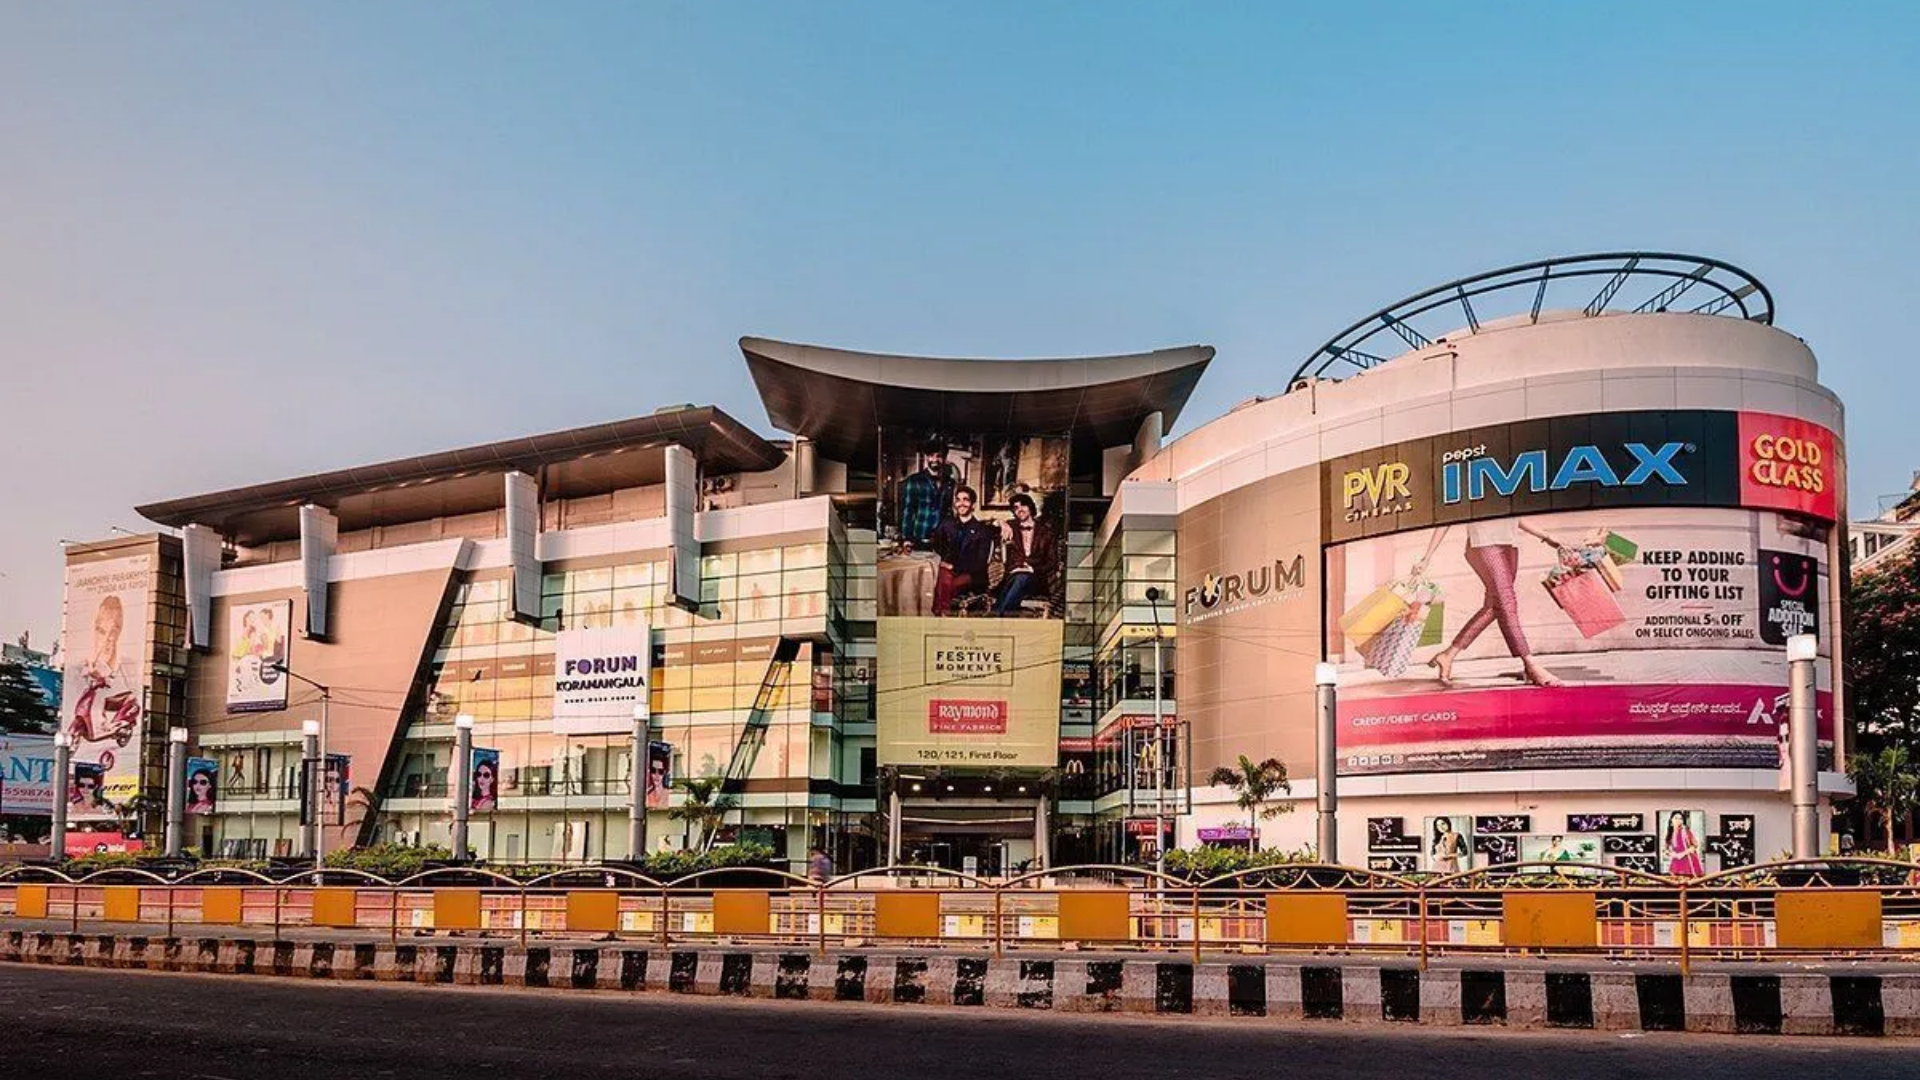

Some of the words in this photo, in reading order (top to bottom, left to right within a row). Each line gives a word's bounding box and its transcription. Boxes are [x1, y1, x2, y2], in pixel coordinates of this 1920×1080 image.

[1443, 444, 1487, 464] pepsi
[1754, 433, 1821, 465] GOLD
[1442, 442, 1689, 504] IMAX
[1752, 459, 1823, 493] CLASS
[1343, 462, 1411, 508] PVR
[1345, 502, 1413, 523] CINEMAS
[1642, 551, 1682, 565] KEEP
[1687, 551, 1745, 566] ADDING
[1661, 568, 1682, 582] TO
[1688, 568, 1729, 582] YOUR
[1184, 554, 1305, 616] FORUM
[1645, 585, 1709, 599] GIFTING
[1715, 585, 1744, 600] LIST
[1645, 616, 1701, 625] ADDITIONAL
[1768, 608, 1814, 627] ADDITION
[1635, 628, 1650, 637] ON
[1653, 628, 1683, 637] SELECT
[1686, 628, 1730, 638] ONGOING
[1732, 629, 1754, 639] SALES
[936, 651, 1002, 662] FESTIVE
[565, 655, 637, 676] FORUM
[935, 663, 1003, 673] MOMENTS
[556, 676, 645, 692] KORAMANGALA
[938, 704, 999, 722] Raymond
[1352, 714, 1418, 726] CREDIT/DEBIT
[1421, 712, 1457, 721] CARDS
[918, 750, 967, 760] 120/121,
[969, 751, 992, 760] First
[993, 751, 1019, 760] Floor
